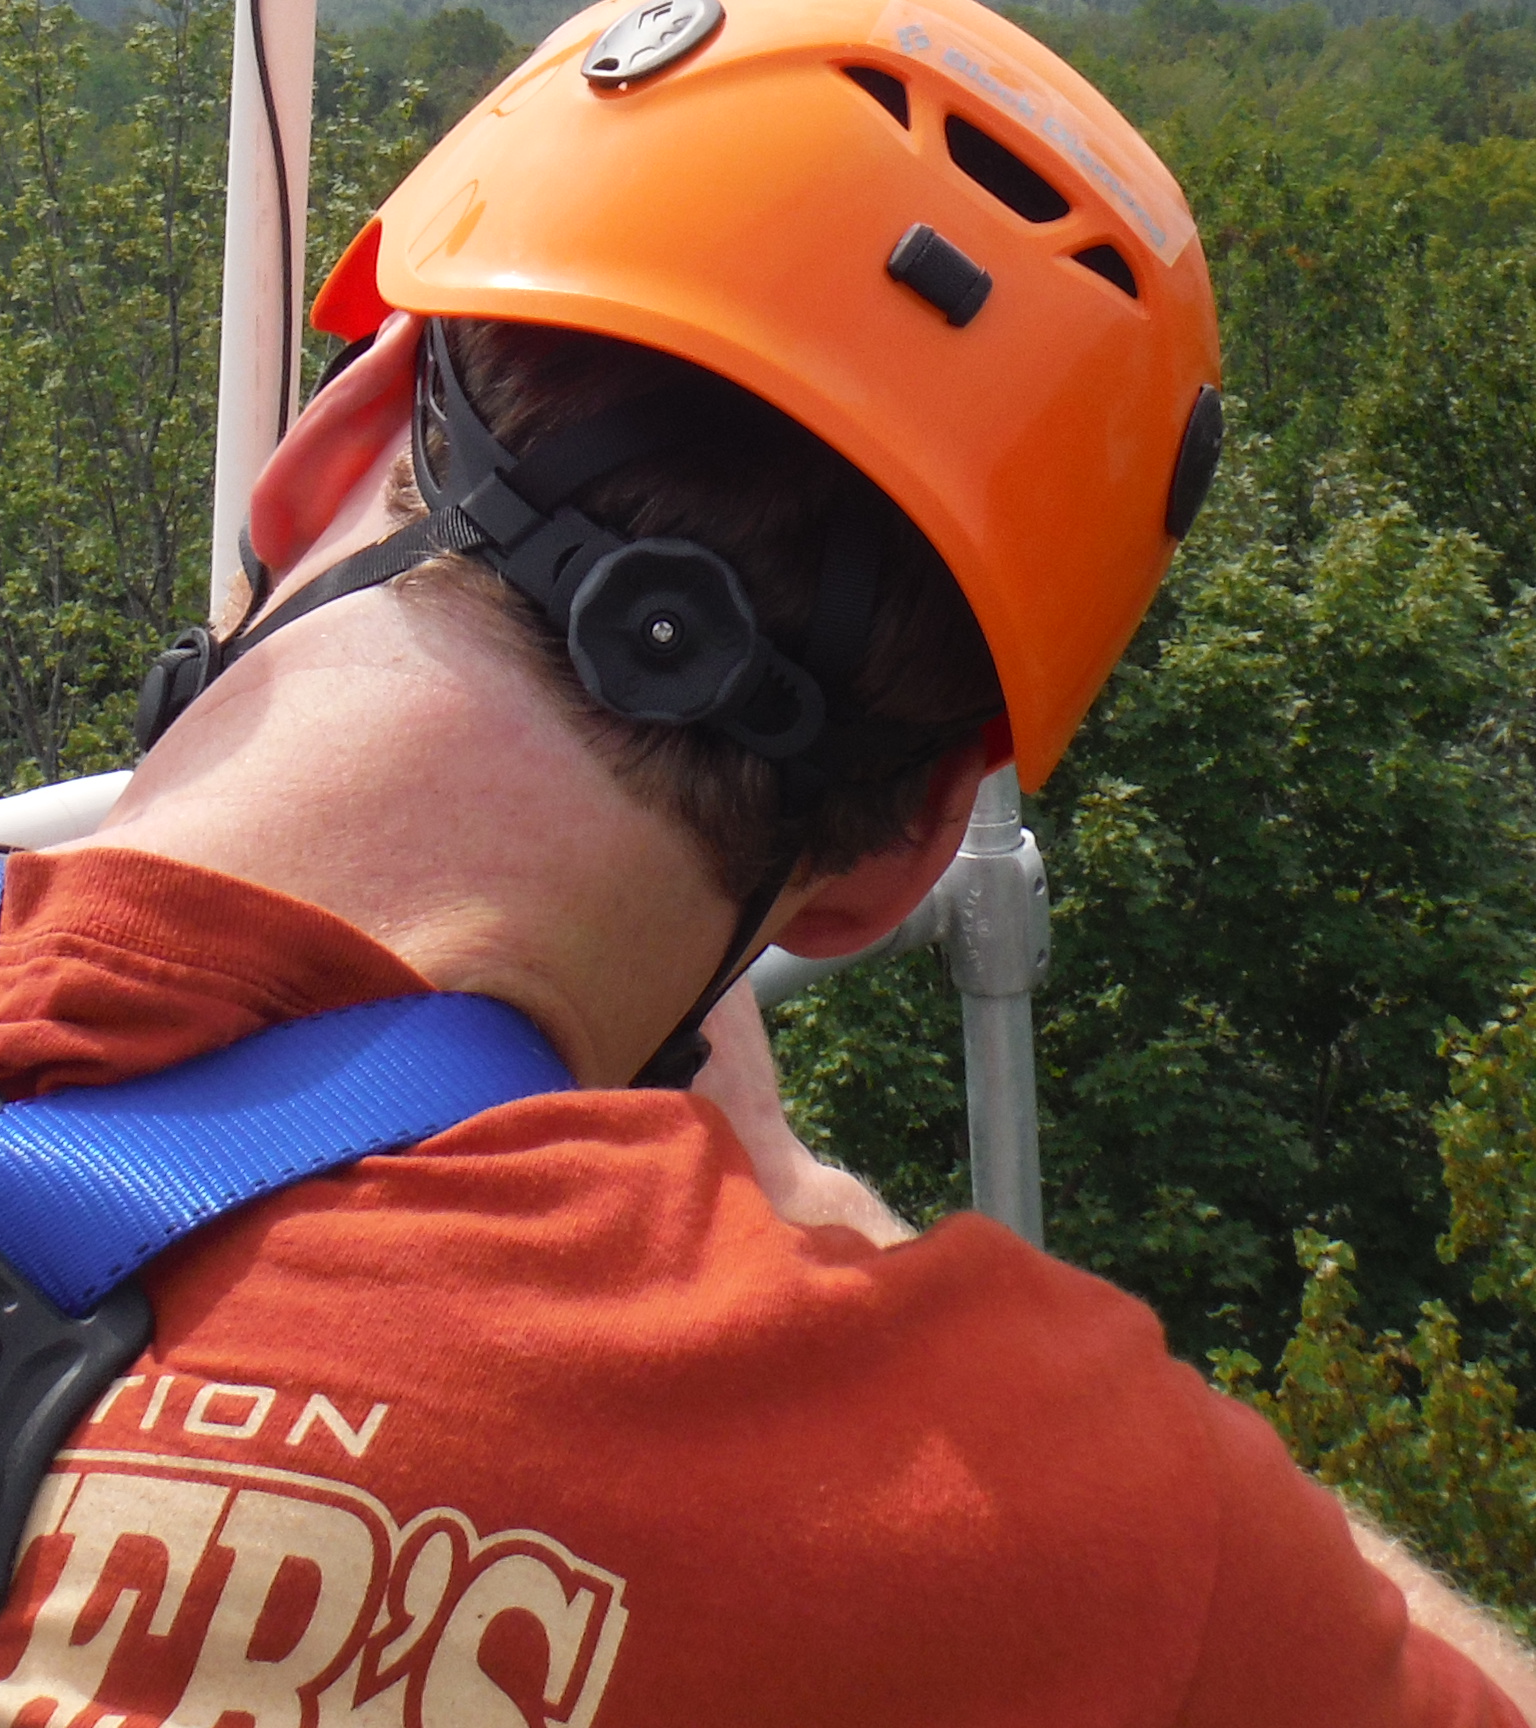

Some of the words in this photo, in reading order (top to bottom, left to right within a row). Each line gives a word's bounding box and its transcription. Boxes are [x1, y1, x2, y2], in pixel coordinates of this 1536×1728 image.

[942, 47, 1035, 120] Black
[1041, 115, 1167, 249] Diamond
[88, 1373, 389, 1460] TION
